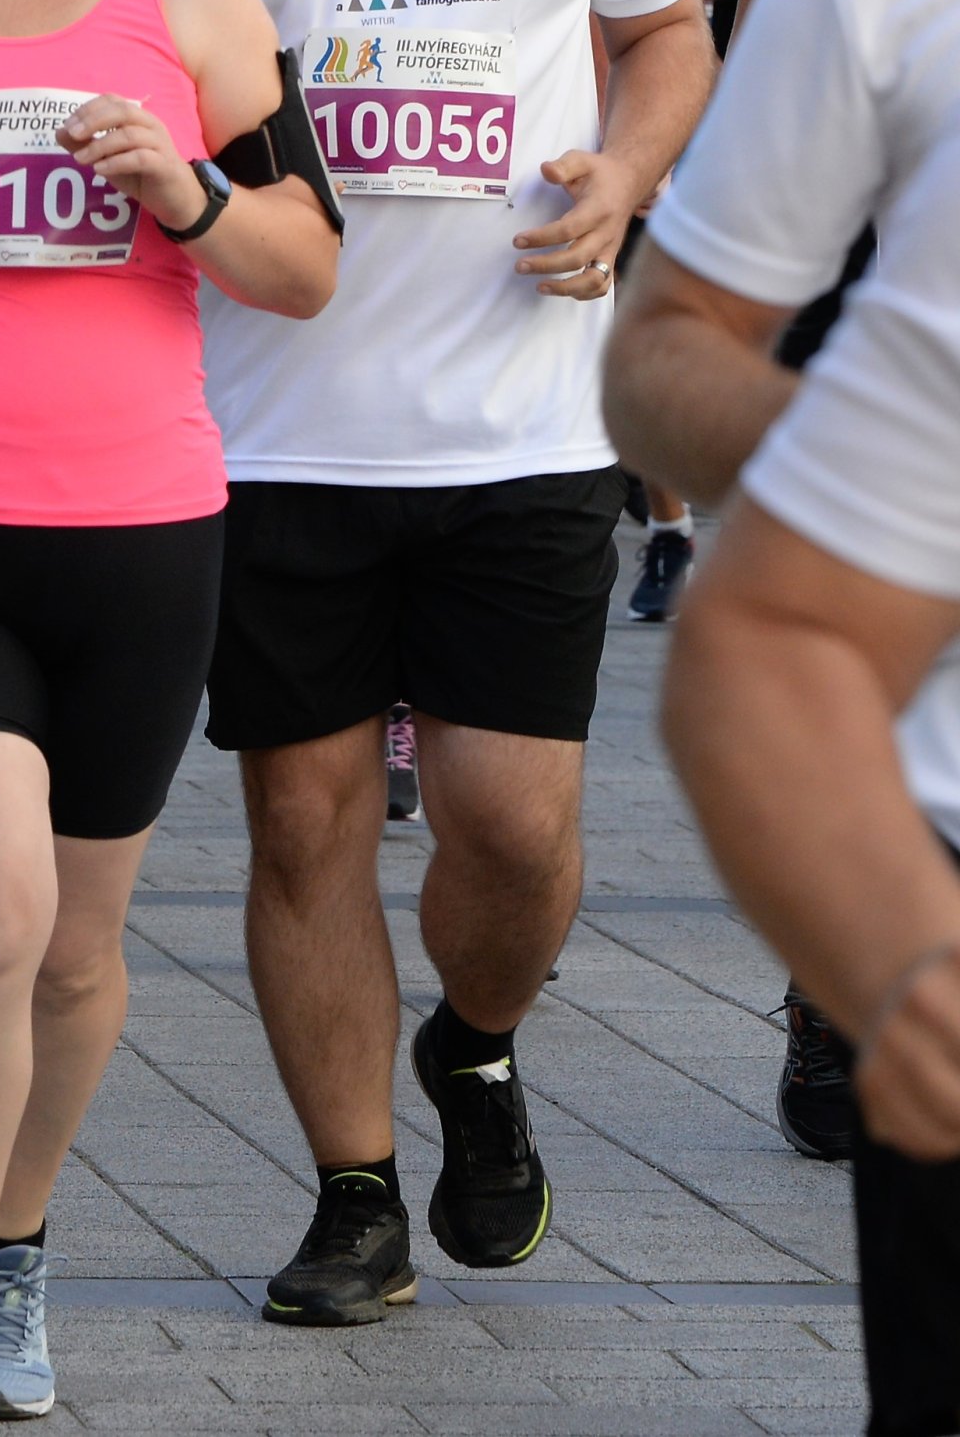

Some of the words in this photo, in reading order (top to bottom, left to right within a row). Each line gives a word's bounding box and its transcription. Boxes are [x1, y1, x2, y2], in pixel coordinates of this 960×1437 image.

[336, 3, 343, 12] a
[361, 16, 395, 27] WITTUR
[396, 37, 503, 59] III.NYÍREGYHÁZI
[396, 53, 502, 74] FUTÓFESZTIVÁL
[314, 100, 508, 164] 10056
